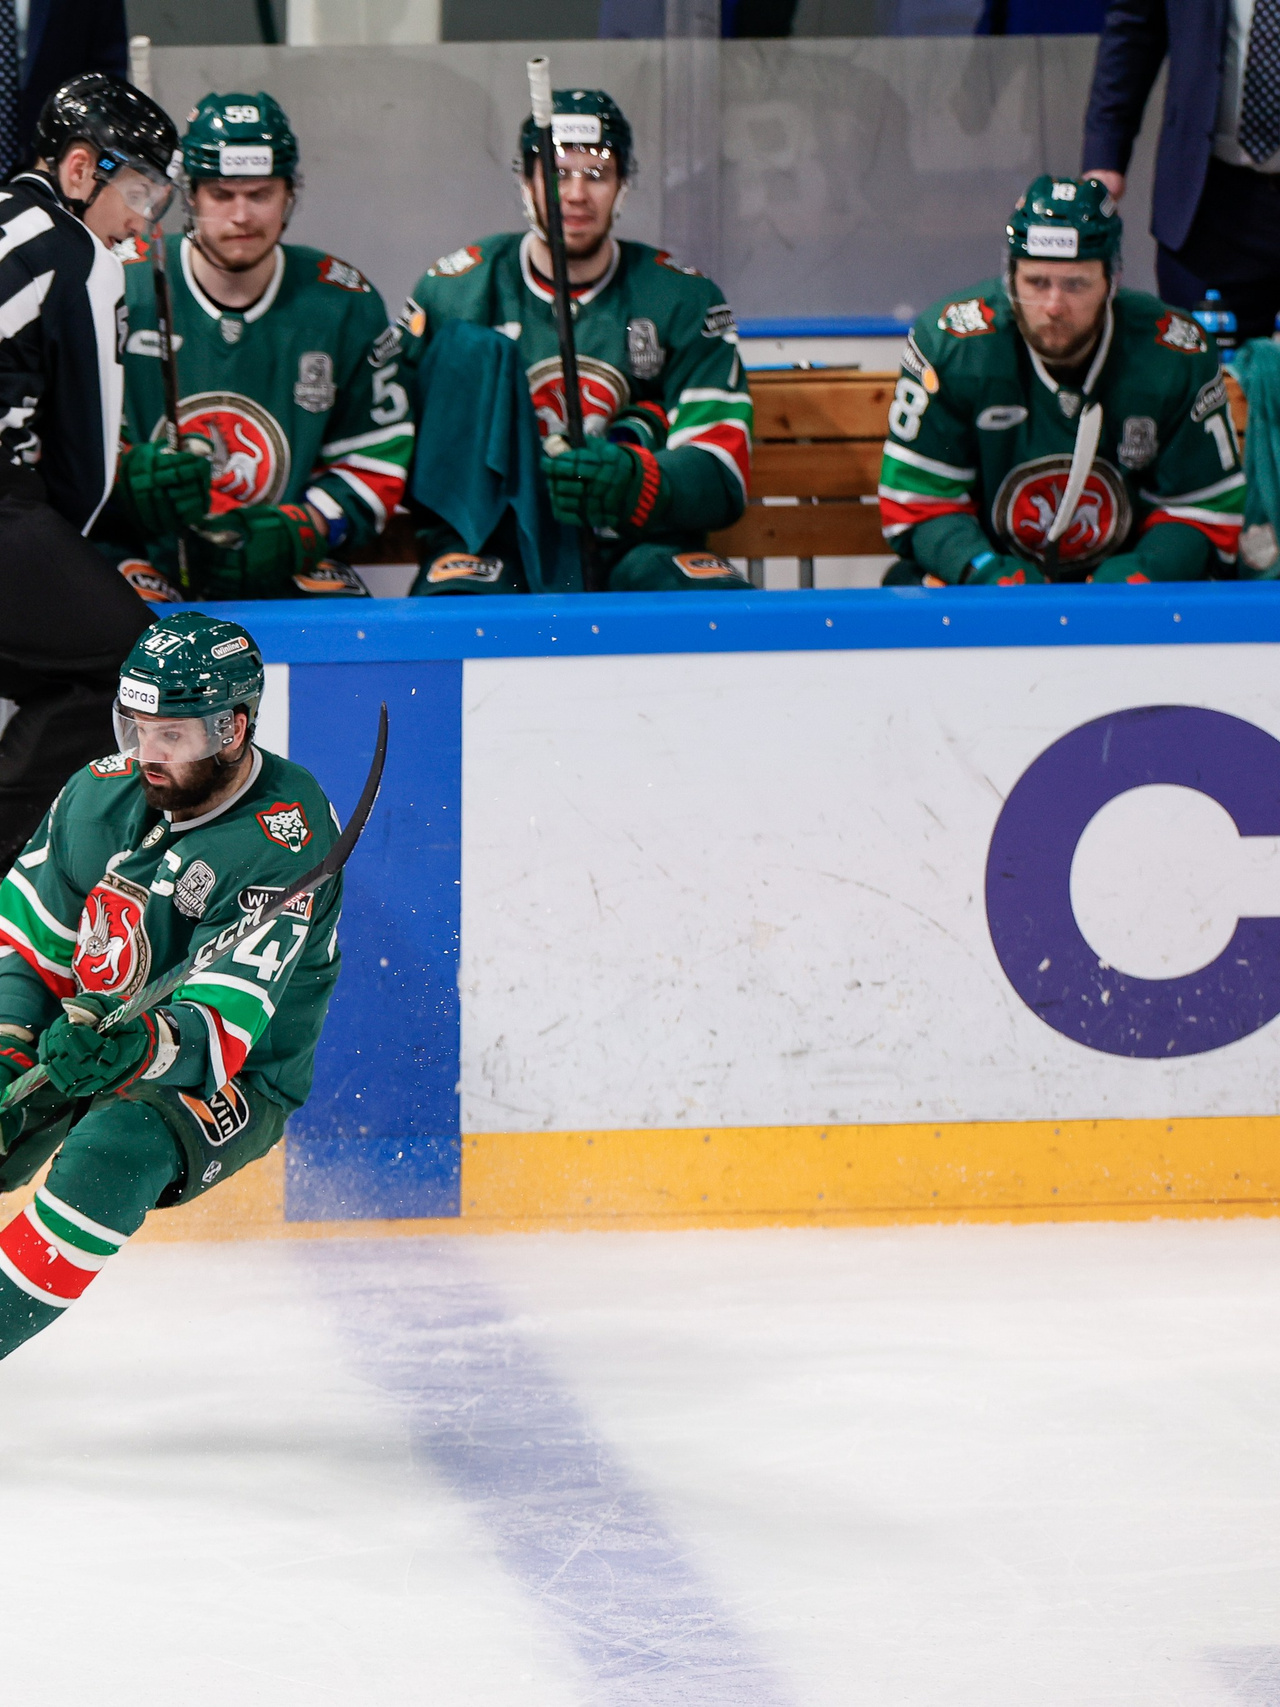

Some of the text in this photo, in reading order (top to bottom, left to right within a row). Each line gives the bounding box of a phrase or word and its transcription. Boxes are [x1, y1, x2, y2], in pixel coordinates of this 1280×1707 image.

[224, 105, 261, 124] 59
[888, 377, 930, 443] 8
[143, 630, 184, 657] 47
[120, 685, 157, 706] согаз
[194, 905, 267, 966] CCM
[232, 919, 309, 983] 47
